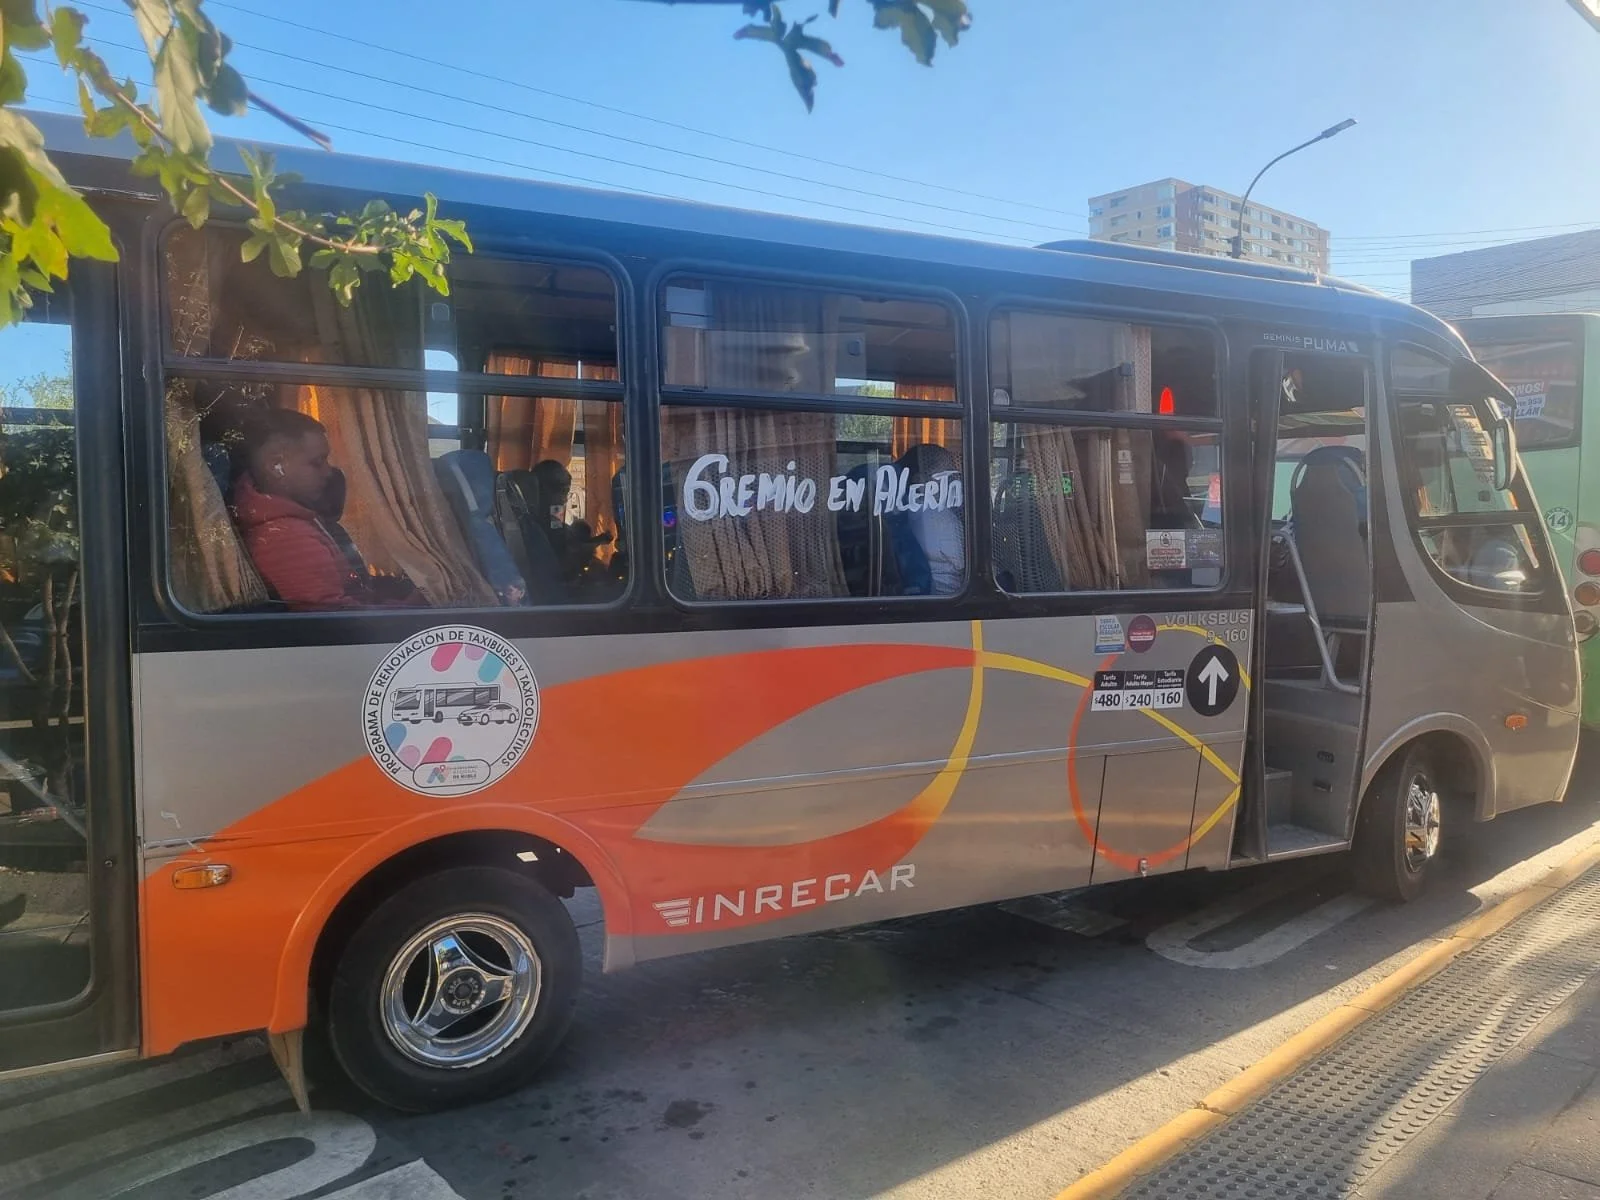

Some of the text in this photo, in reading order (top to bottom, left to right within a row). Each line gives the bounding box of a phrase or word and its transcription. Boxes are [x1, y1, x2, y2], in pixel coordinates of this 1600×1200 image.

[1263, 333, 1347, 352] GEMINIS PUMA
[827, 475, 866, 512] EN
[873, 464, 964, 517] ALERTA
[1548, 514, 1566, 527] 14
[1165, 611, 1249, 627] VOLKSBUS
[1207, 628, 1248, 643] 9-160
[367, 630, 534, 775] PROGRAMA DE RENOVACIÓN DE TAXIBUSES Y TAXICOLECTIVOS
[695, 863, 916, 924] INRECAR
